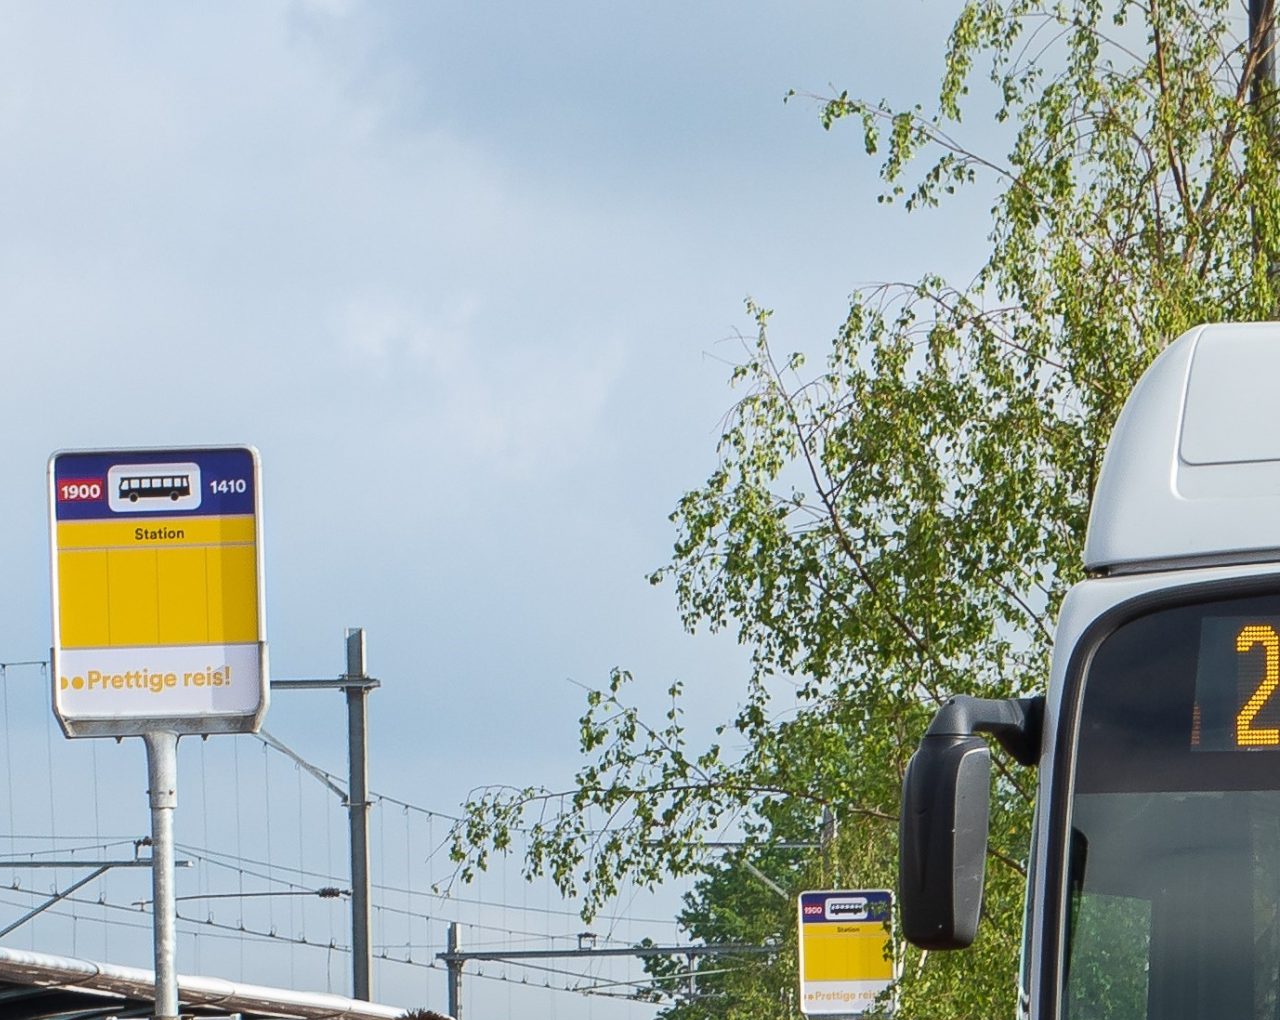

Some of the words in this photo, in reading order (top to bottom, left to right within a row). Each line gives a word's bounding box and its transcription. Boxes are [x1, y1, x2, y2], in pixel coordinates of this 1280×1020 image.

[61, 484, 101, 499] 1900
[210, 479, 246, 494] 1410
[135, 527, 185, 540] Station
[87, 668, 178, 693] Prettige
[183, 666, 232, 687] reis!
[1236, 625, 1280, 746] 2
